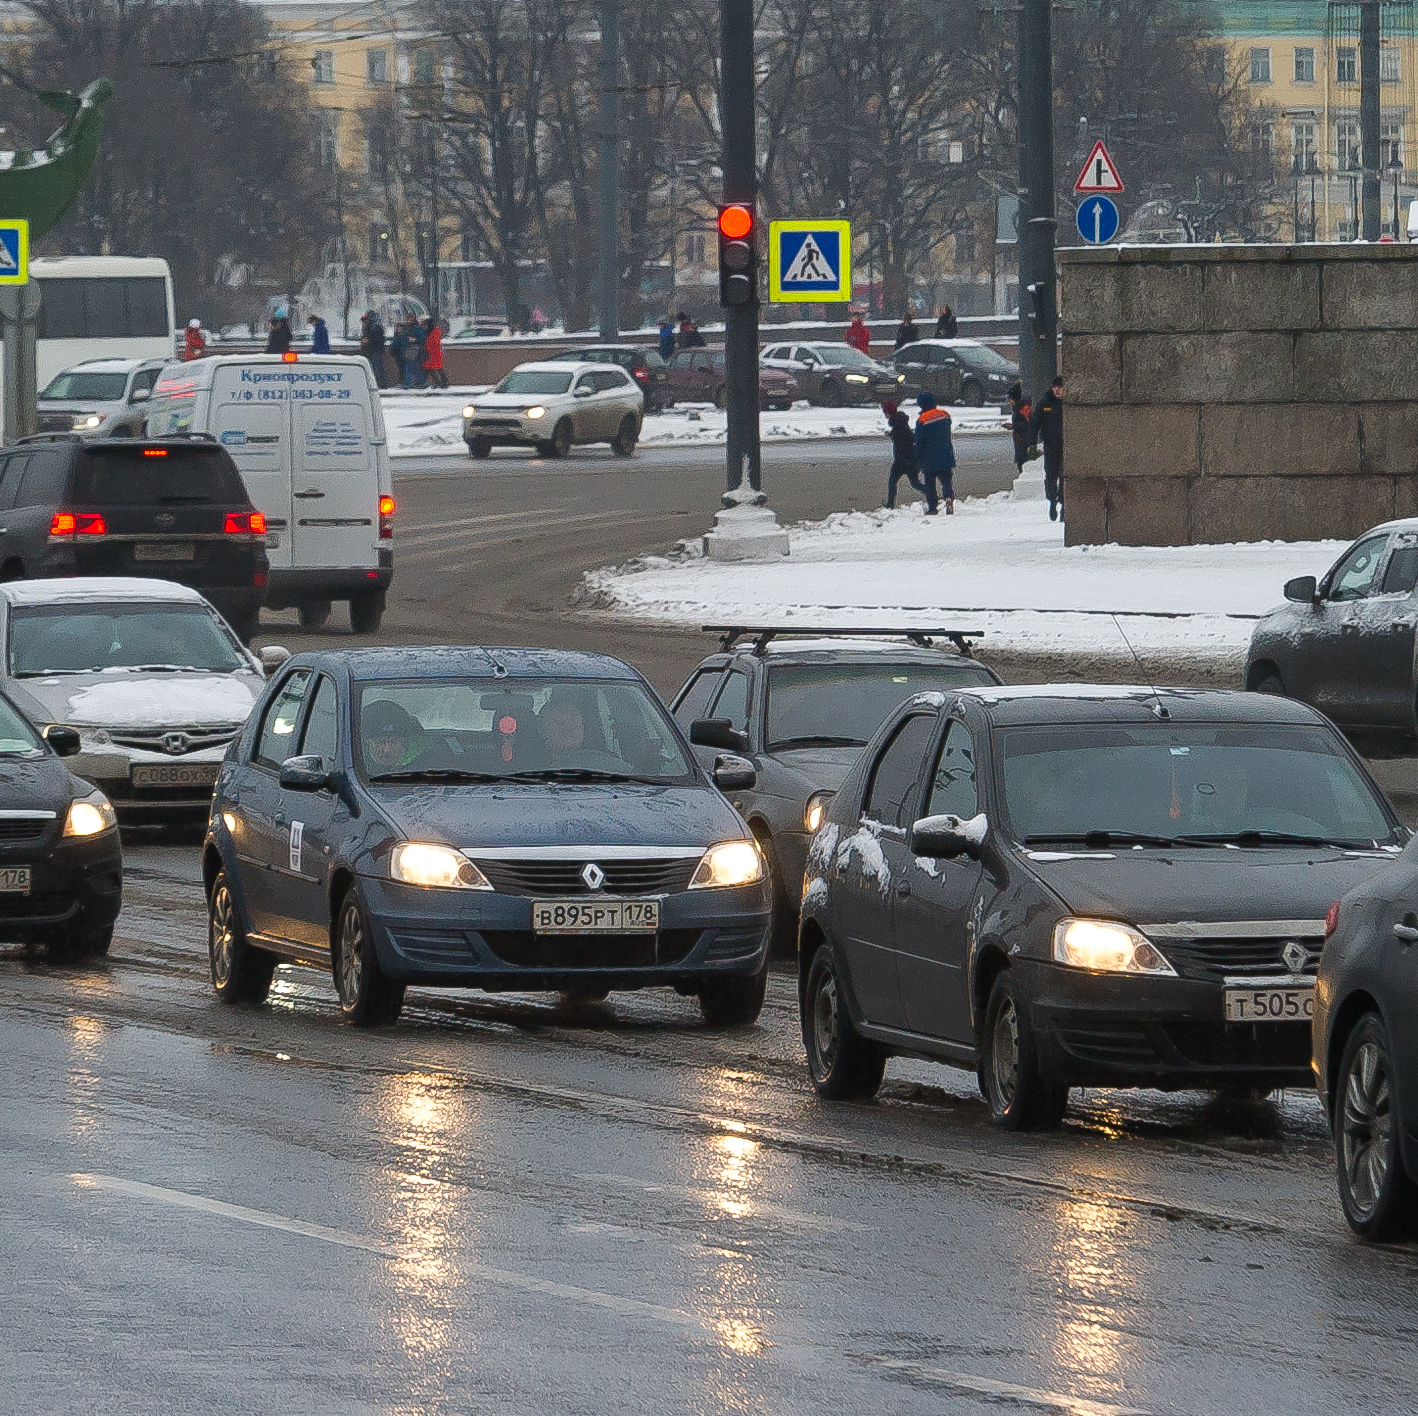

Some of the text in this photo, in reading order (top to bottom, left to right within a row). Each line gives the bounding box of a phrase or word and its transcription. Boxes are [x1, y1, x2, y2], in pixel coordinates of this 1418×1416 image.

[241, 369, 343, 384] Криопродукт
[257, 389, 288, 401] (812)
[624, 904, 655, 921] 178
